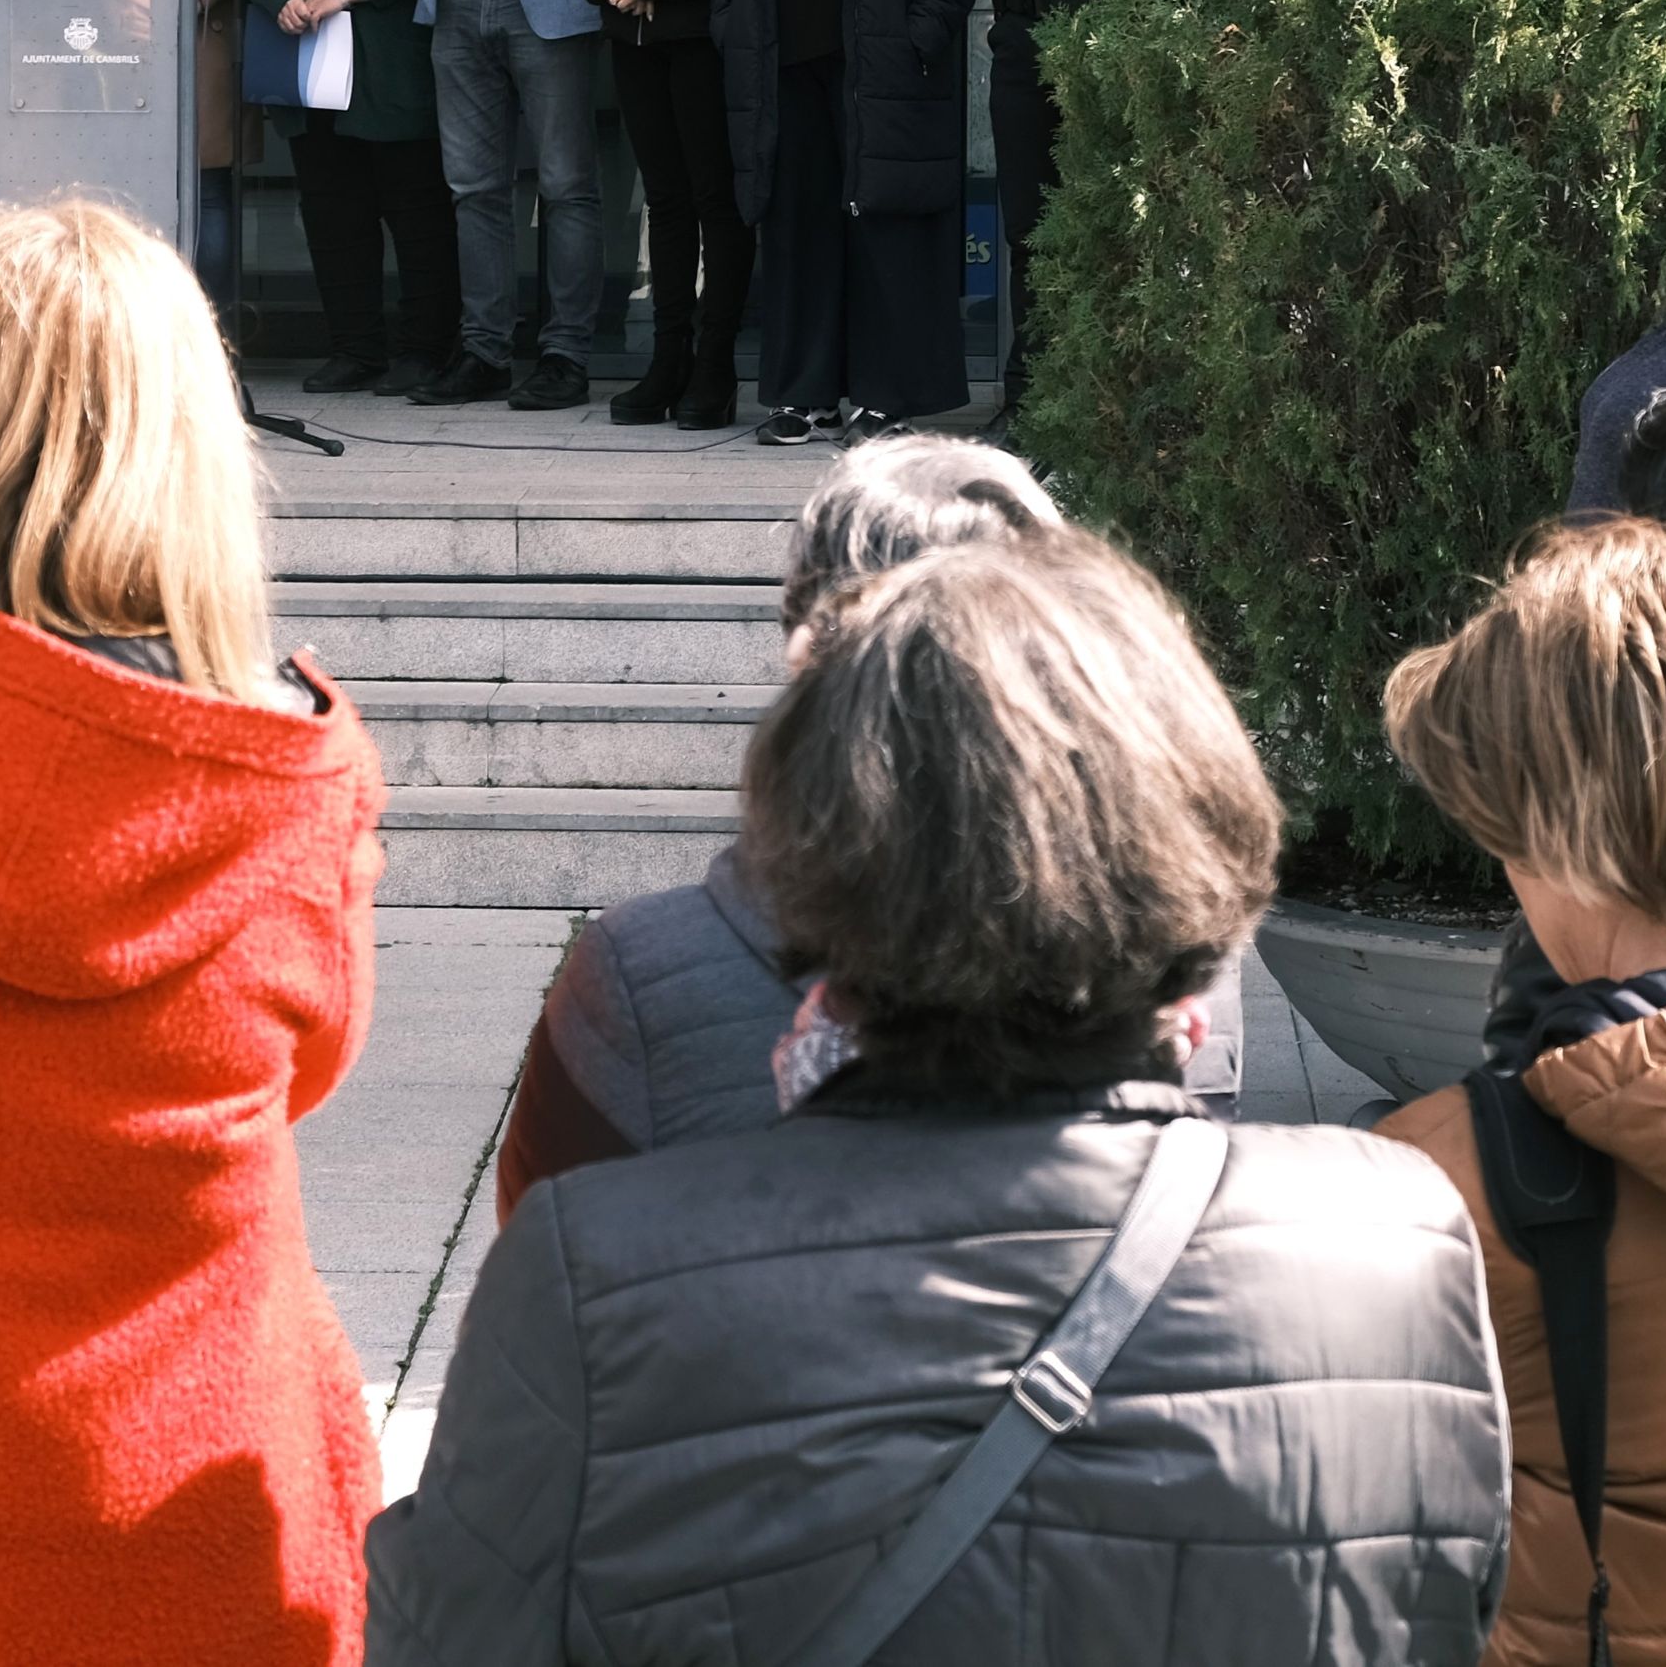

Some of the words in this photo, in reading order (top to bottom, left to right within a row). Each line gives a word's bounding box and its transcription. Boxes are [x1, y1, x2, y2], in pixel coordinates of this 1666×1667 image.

[22, 54, 81, 64] AJUNTAMENT
[82, 54, 94, 64] DE
[96, 54, 141, 64] CAMBRILS
